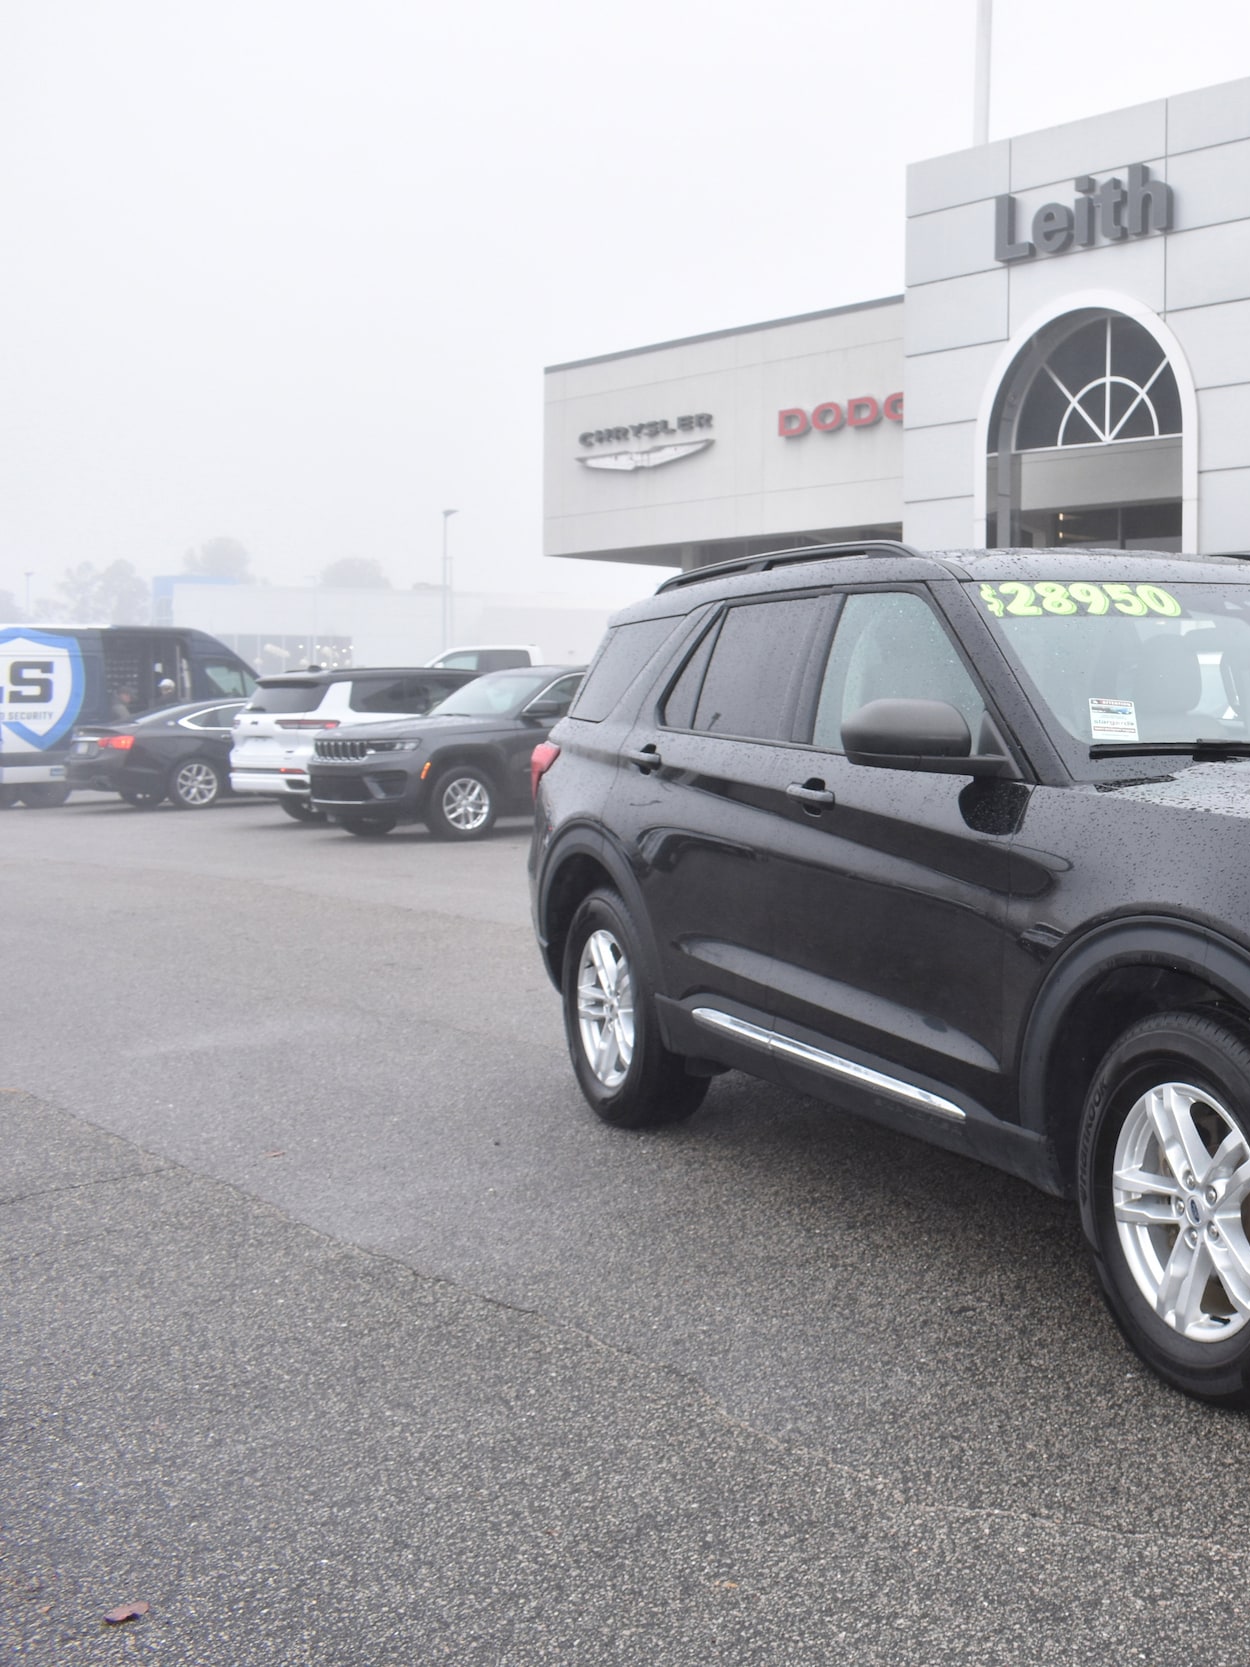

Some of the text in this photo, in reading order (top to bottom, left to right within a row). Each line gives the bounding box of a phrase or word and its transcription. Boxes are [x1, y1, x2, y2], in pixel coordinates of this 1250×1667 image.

[994, 163, 1174, 263] Leith
[578, 412, 714, 447] CHRYSLER
[979, 581, 1182, 617] $28950
[0, 661, 54, 704] S
[8, 711, 54, 721] SECURITY
